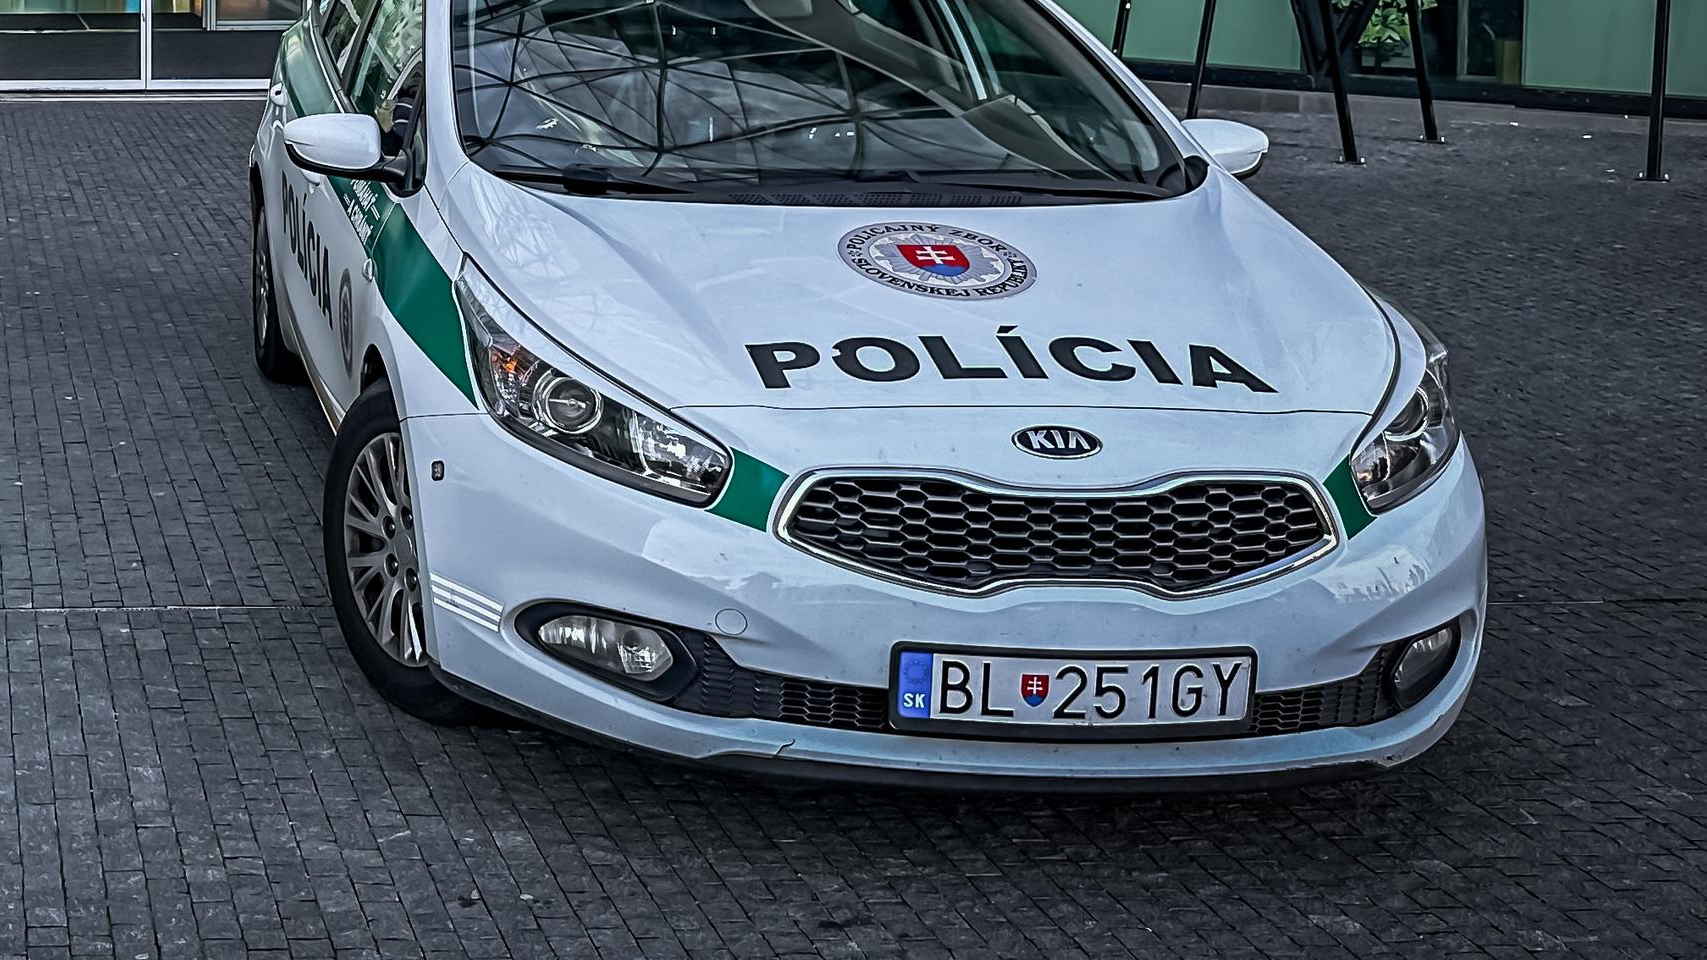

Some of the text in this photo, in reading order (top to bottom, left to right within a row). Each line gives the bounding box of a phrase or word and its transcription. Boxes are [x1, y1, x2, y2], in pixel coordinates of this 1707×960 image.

[282, 169, 333, 330] POLÍCIA
[846, 224, 1007, 252] POLICAJNÝ ZBOR
[852, 257, 971, 297] SLOVENSKEJ
[746, 325, 1279, 393] POLÍCIA
[1029, 429, 1089, 450] KIA
[903, 660, 1243, 720] SK BL 251GY
